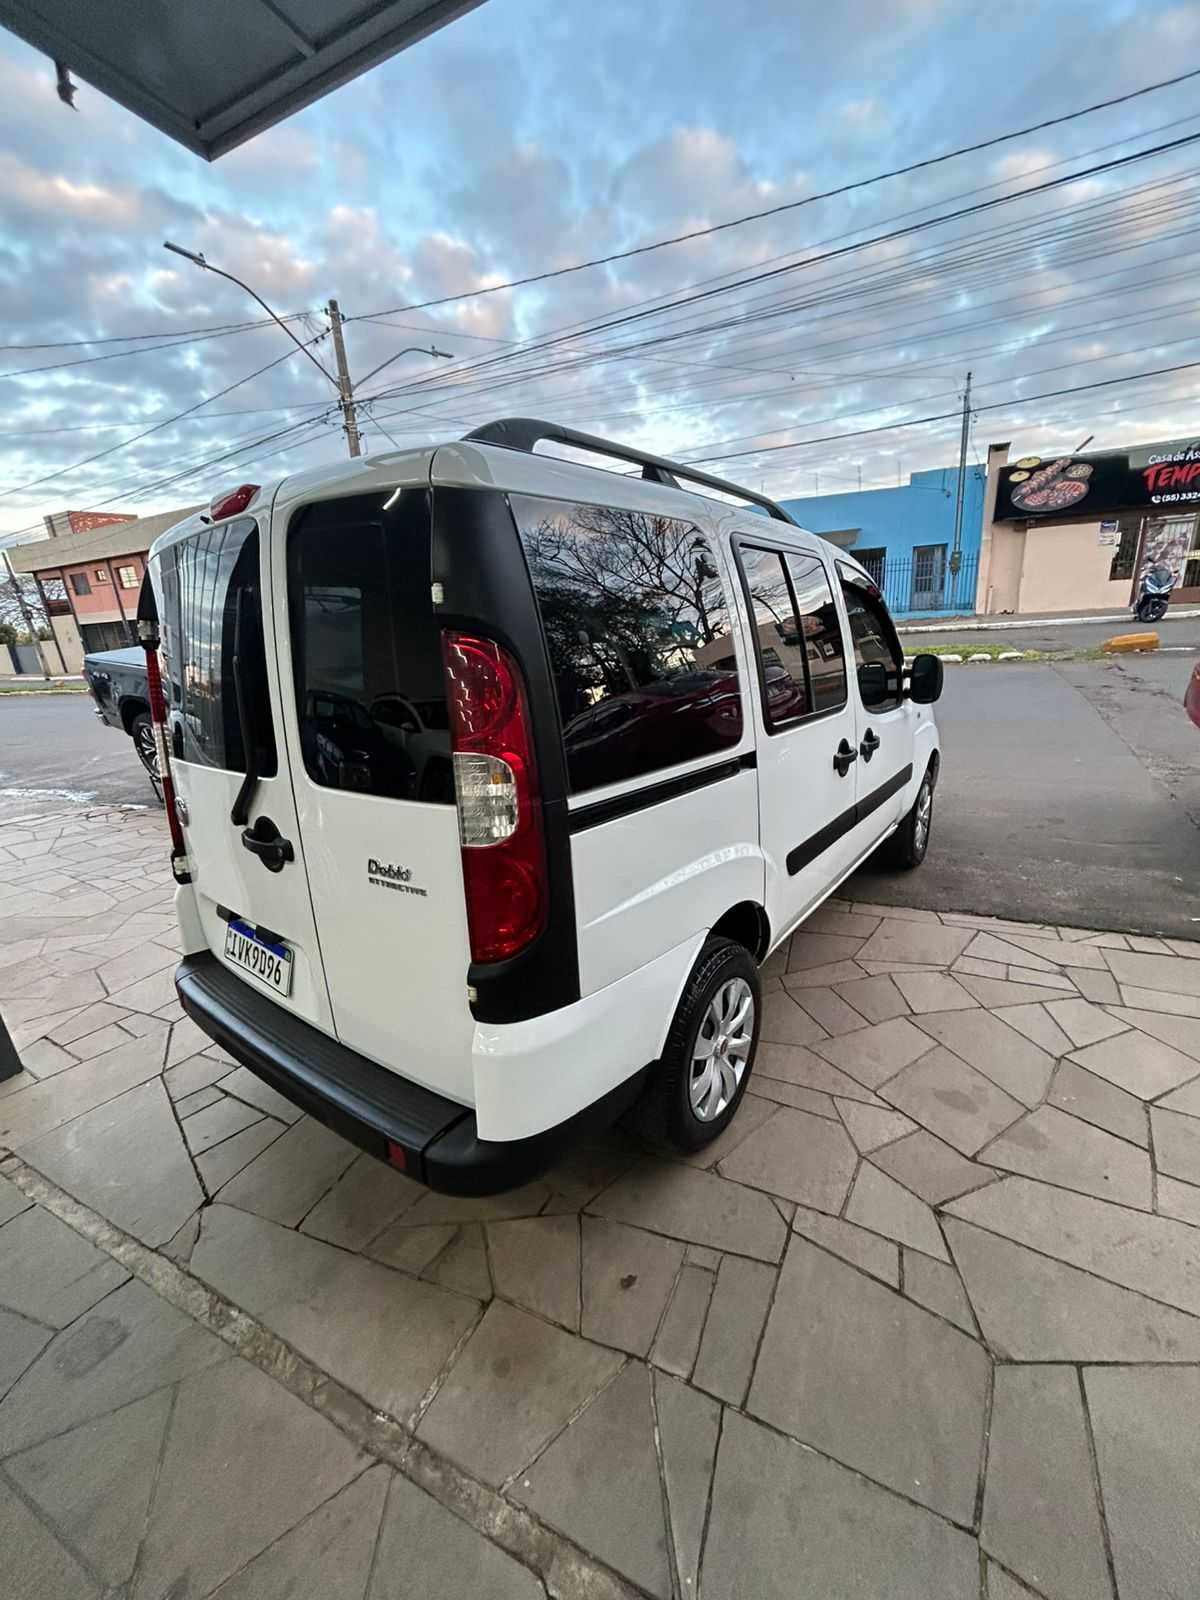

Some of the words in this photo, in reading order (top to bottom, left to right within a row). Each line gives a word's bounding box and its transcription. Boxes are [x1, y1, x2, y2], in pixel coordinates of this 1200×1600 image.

[1148, 454, 1172, 465] Casa
[1173, 450, 1185, 461] de
[230, 933, 282, 986] IVK9D96
